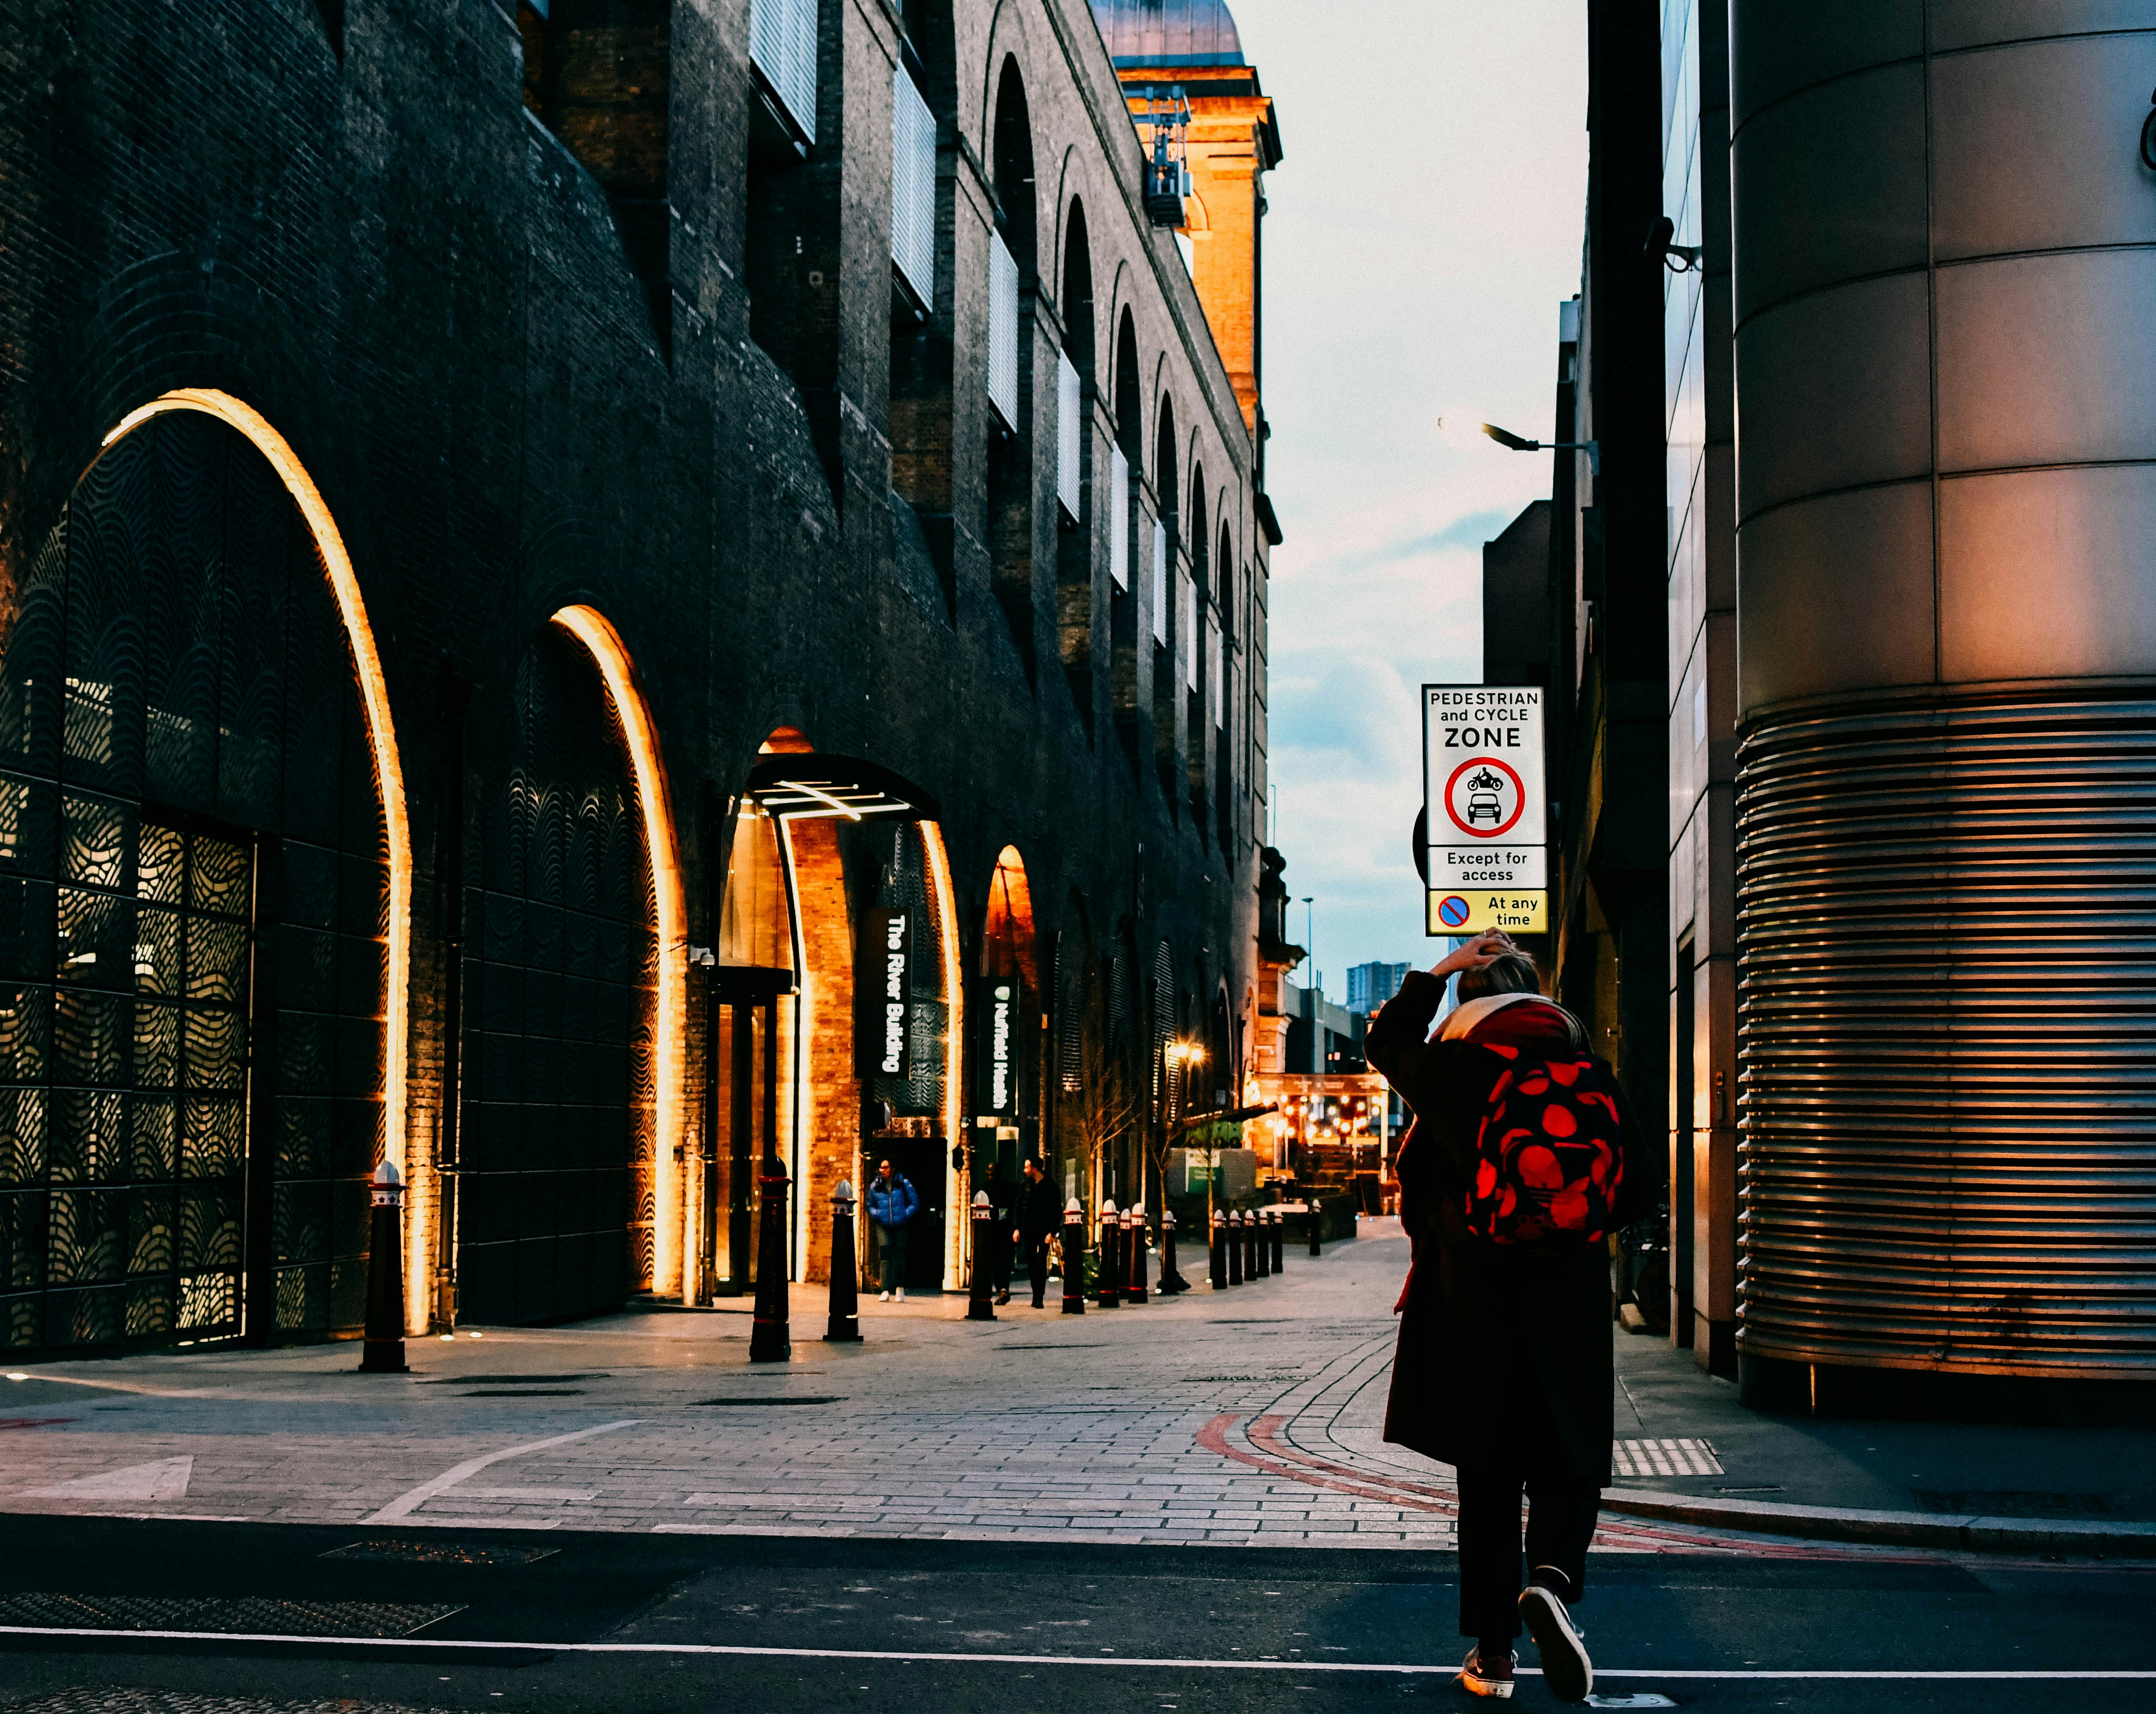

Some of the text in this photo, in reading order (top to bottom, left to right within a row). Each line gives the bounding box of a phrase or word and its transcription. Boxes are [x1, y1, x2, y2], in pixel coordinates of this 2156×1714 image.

[1431, 693, 1537, 705] PEDESTRIAN
[1441, 709, 1528, 721] and CYCLE
[1445, 728, 1520, 747] ZONE
[1448, 852, 1527, 866] Except for
[1463, 872, 1512, 880] access
[1489, 897, 1537, 911] At any
[1497, 913, 1530, 925] time
[882, 915, 905, 1072] The River Building
